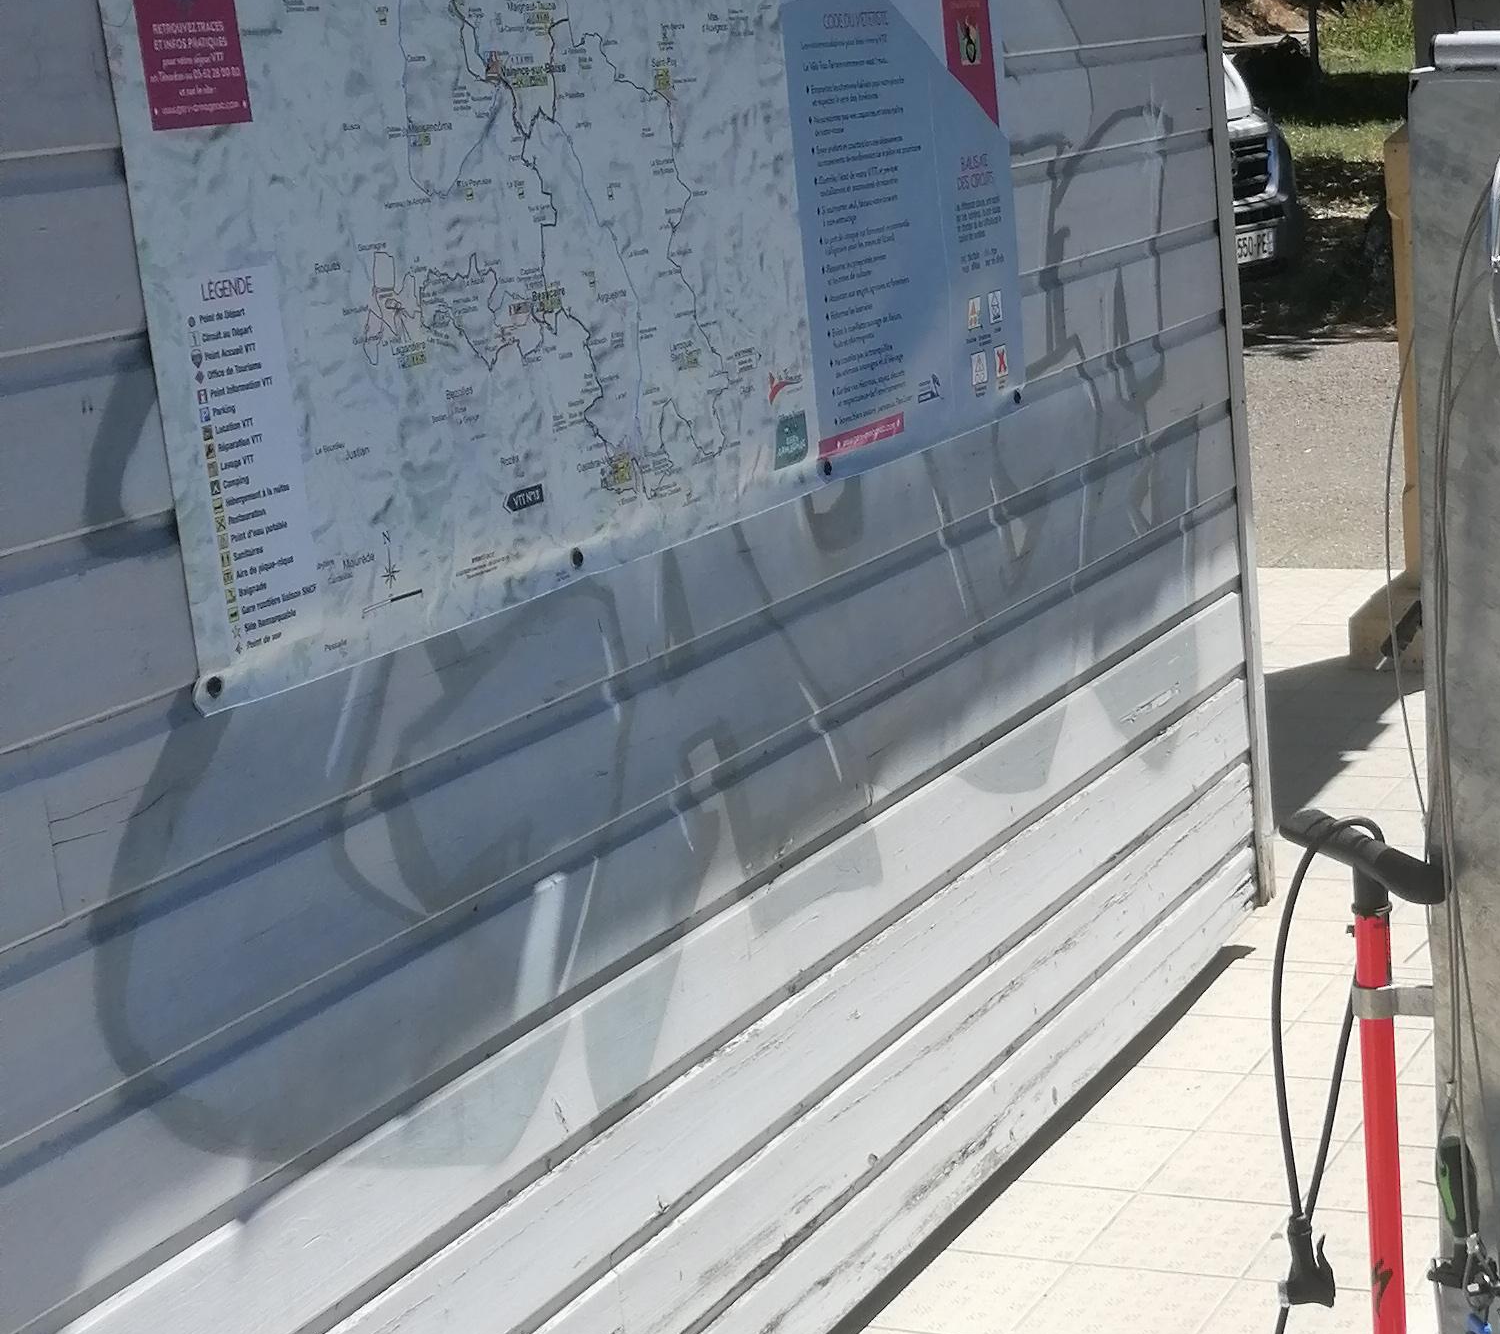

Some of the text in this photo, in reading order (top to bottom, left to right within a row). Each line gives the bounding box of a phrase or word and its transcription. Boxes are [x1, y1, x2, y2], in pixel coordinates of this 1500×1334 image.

[201, 276, 254, 301] LÉGENDE
[199, 313, 212, 323] Point
[224, 308, 245, 319] Départ
[232, 325, 253, 338] Départ
[205, 342, 256, 361] Point Accueil VTT
[207, 369, 224, 380] Office
[235, 362, 262, 373] Tourisme
[210, 376, 273, 398] Point Information VTT
[212, 404, 236, 417] Parking
[215, 417, 254, 435] Location VTT
[218, 433, 263, 452] Réparation VTT
[220, 454, 254, 471] Lavage VTT
[223, 475, 250, 489] Camping
[230, 532, 246, 543] Point
[265, 520, 288, 535] potable
[382, 530, 391, 545] N
[233, 546, 264, 561] Sanitaires
[236, 569, 248, 579] Aire
[238, 582, 267, 597] Baignade
[241, 604, 256, 615] Gare
[244, 608, 297, 633] Site Remarquable
[247, 637, 262, 649] Point
